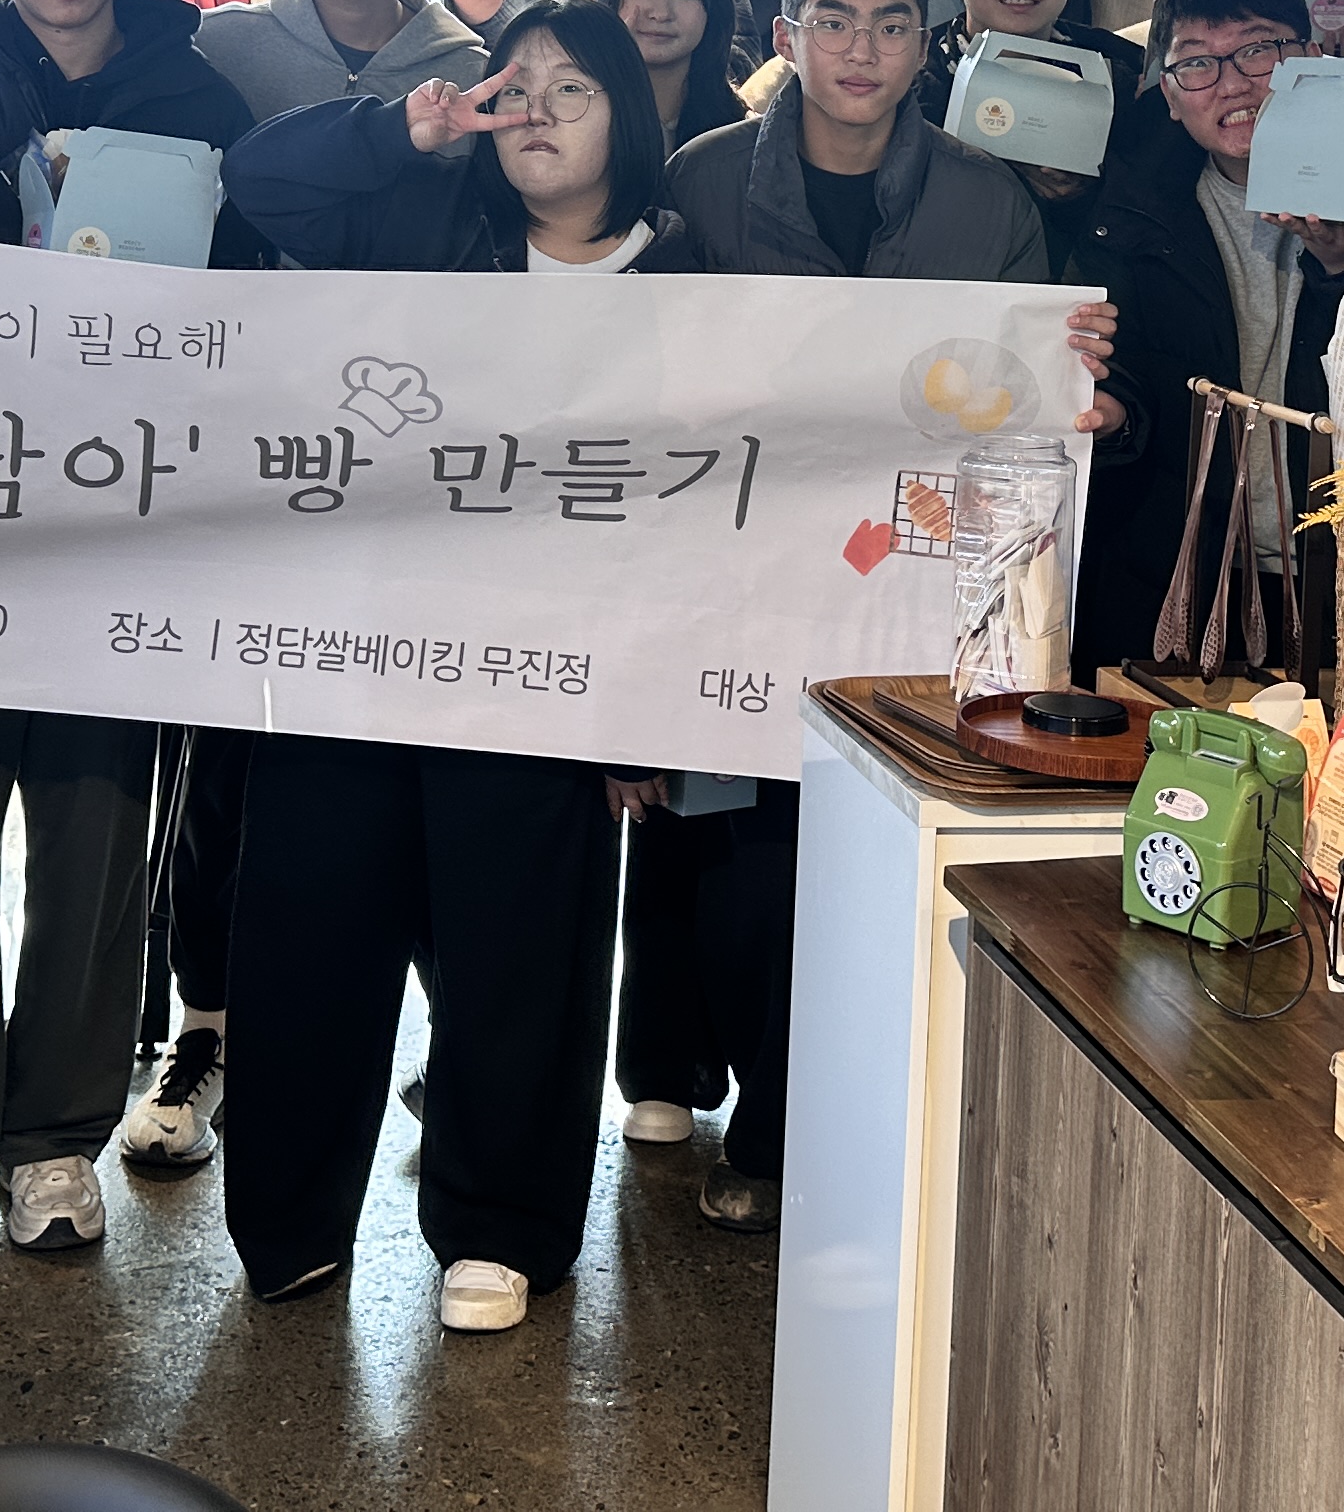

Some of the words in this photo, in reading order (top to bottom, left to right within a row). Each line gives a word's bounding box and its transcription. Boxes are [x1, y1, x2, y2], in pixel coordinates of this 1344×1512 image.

[67, 311, 244, 370] 필요해'
[255, 426, 373, 515] 빵
[431, 432, 762, 531] 만들기
[106, 613, 185, 655] 장소
[235, 622, 466, 683] 정담쌀베이킹
[477, 645, 592, 695] 무진정
[699, 668, 776, 714] 대상
